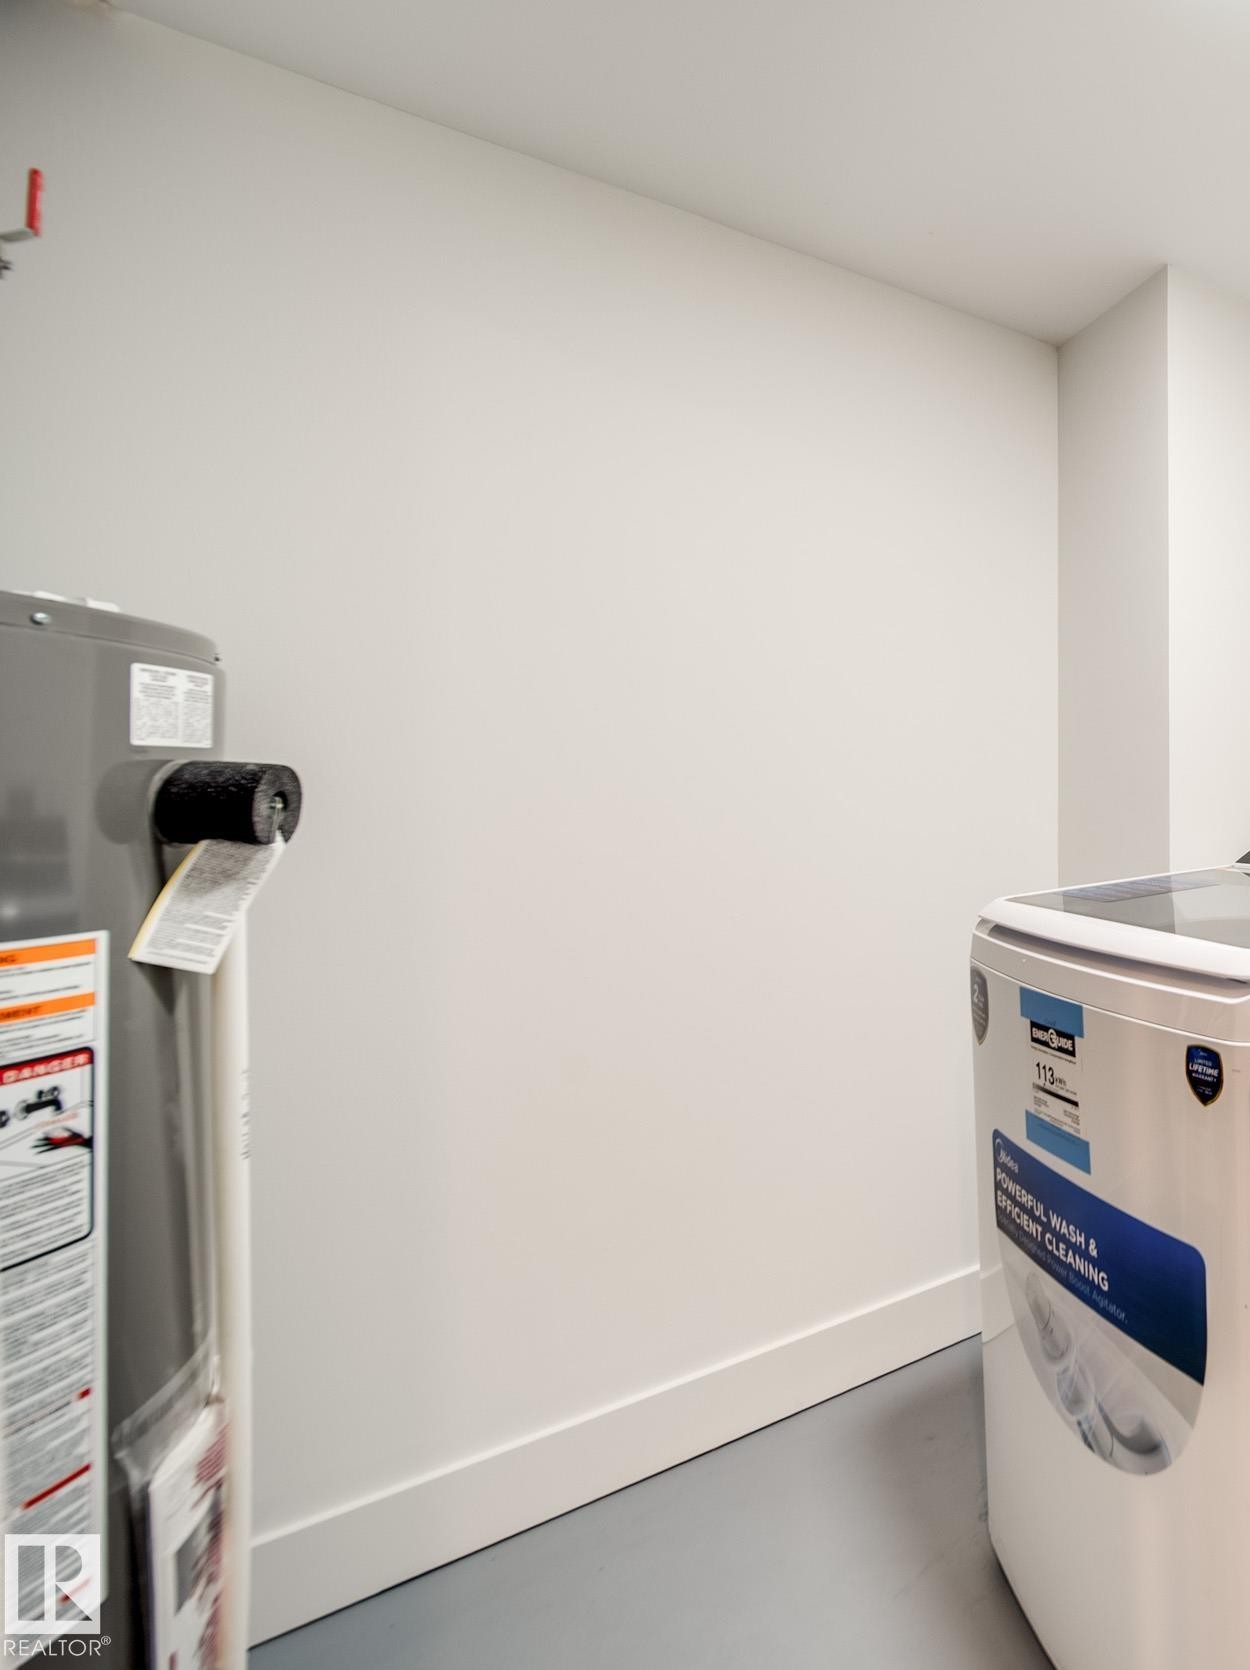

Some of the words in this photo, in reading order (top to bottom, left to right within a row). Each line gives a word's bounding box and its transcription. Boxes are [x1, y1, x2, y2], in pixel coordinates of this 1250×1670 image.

[1036, 1062, 1055, 1085] 113
[1189, 1063, 1219, 1077] LIFETIME
[996, 1168, 1047, 1223] POWERFUL
[1049, 1210, 1085, 1250] WASH
[1088, 1237, 1099, 1258] &
[997, 1191, 1042, 1242] EFFICIENT
[1044, 1232, 1109, 1293] CLEANING
